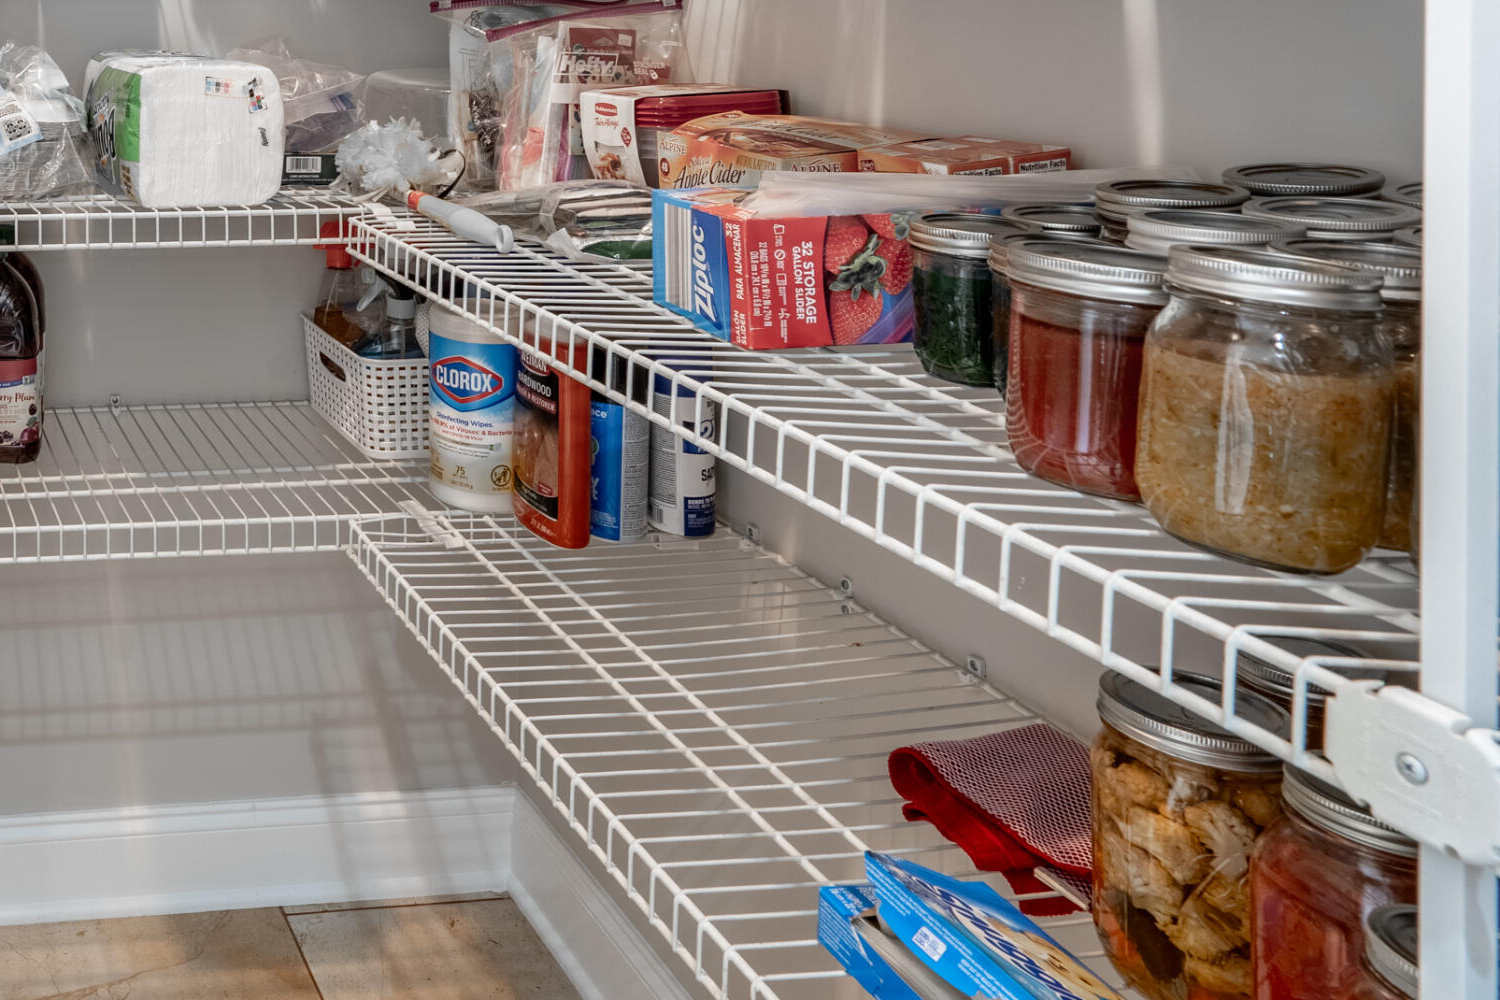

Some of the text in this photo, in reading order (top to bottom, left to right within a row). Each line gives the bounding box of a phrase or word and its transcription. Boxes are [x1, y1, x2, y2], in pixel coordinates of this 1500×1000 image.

[560, 55, 615, 74] Hefty
[660, 138, 687, 154] ALPINE
[673, 161, 746, 189] Apple Cider
[1020, 160, 1066, 171] Nutrition Facts
[726, 222, 733, 237] 32
[692, 224, 717, 322] Ziploc
[732, 224, 744, 299] PARA ALMACENAR
[792, 246, 804, 320] GALLON SLIDER
[802, 241, 817, 324] 32 STORAGE
[436, 365, 493, 393] CLOROX
[518, 370, 552, 397] HARDWOOD
[15, 392, 35, 403] Plum
[470, 420, 493, 428] Wipes
[455, 465, 465, 475] 75
